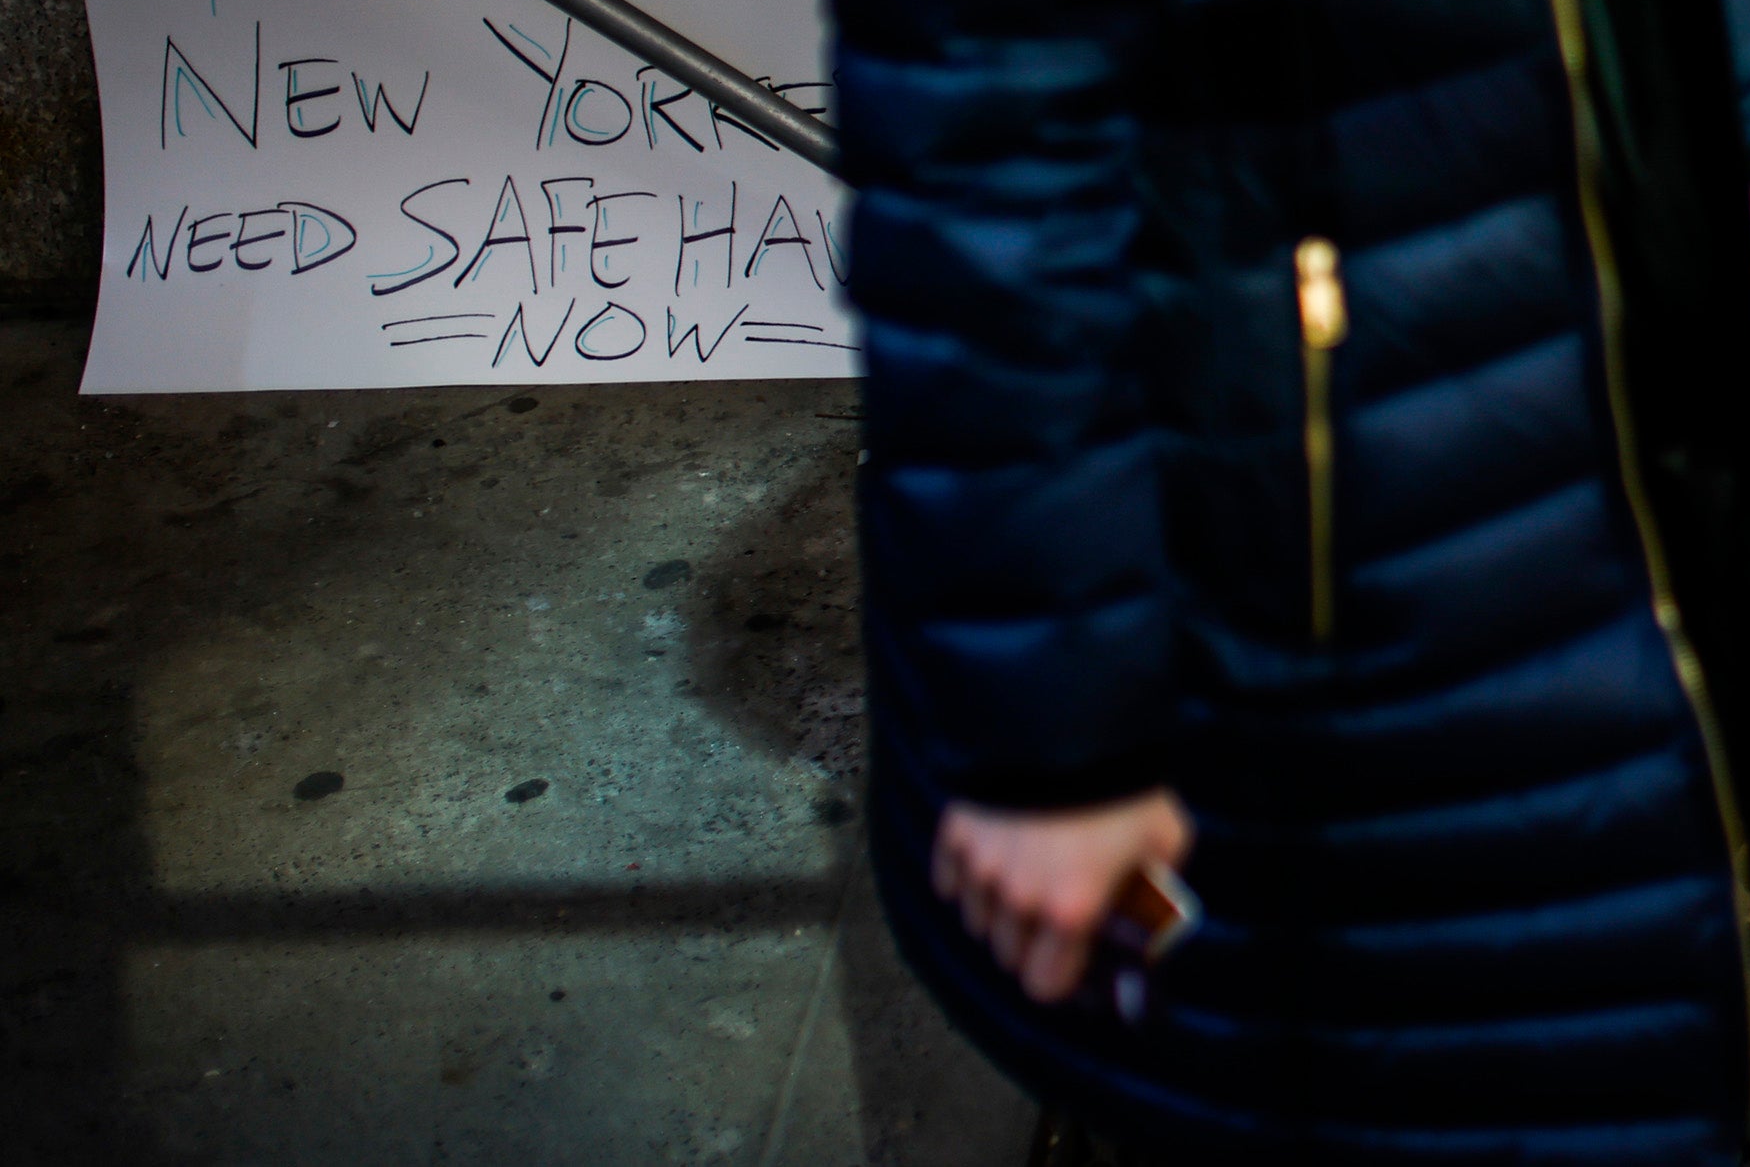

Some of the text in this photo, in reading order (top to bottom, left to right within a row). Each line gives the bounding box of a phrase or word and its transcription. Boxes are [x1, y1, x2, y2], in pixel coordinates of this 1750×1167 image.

[162, 21, 430, 150] NEW
[127, 201, 358, 282] NEED
[367, 175, 658, 295] SAFE
